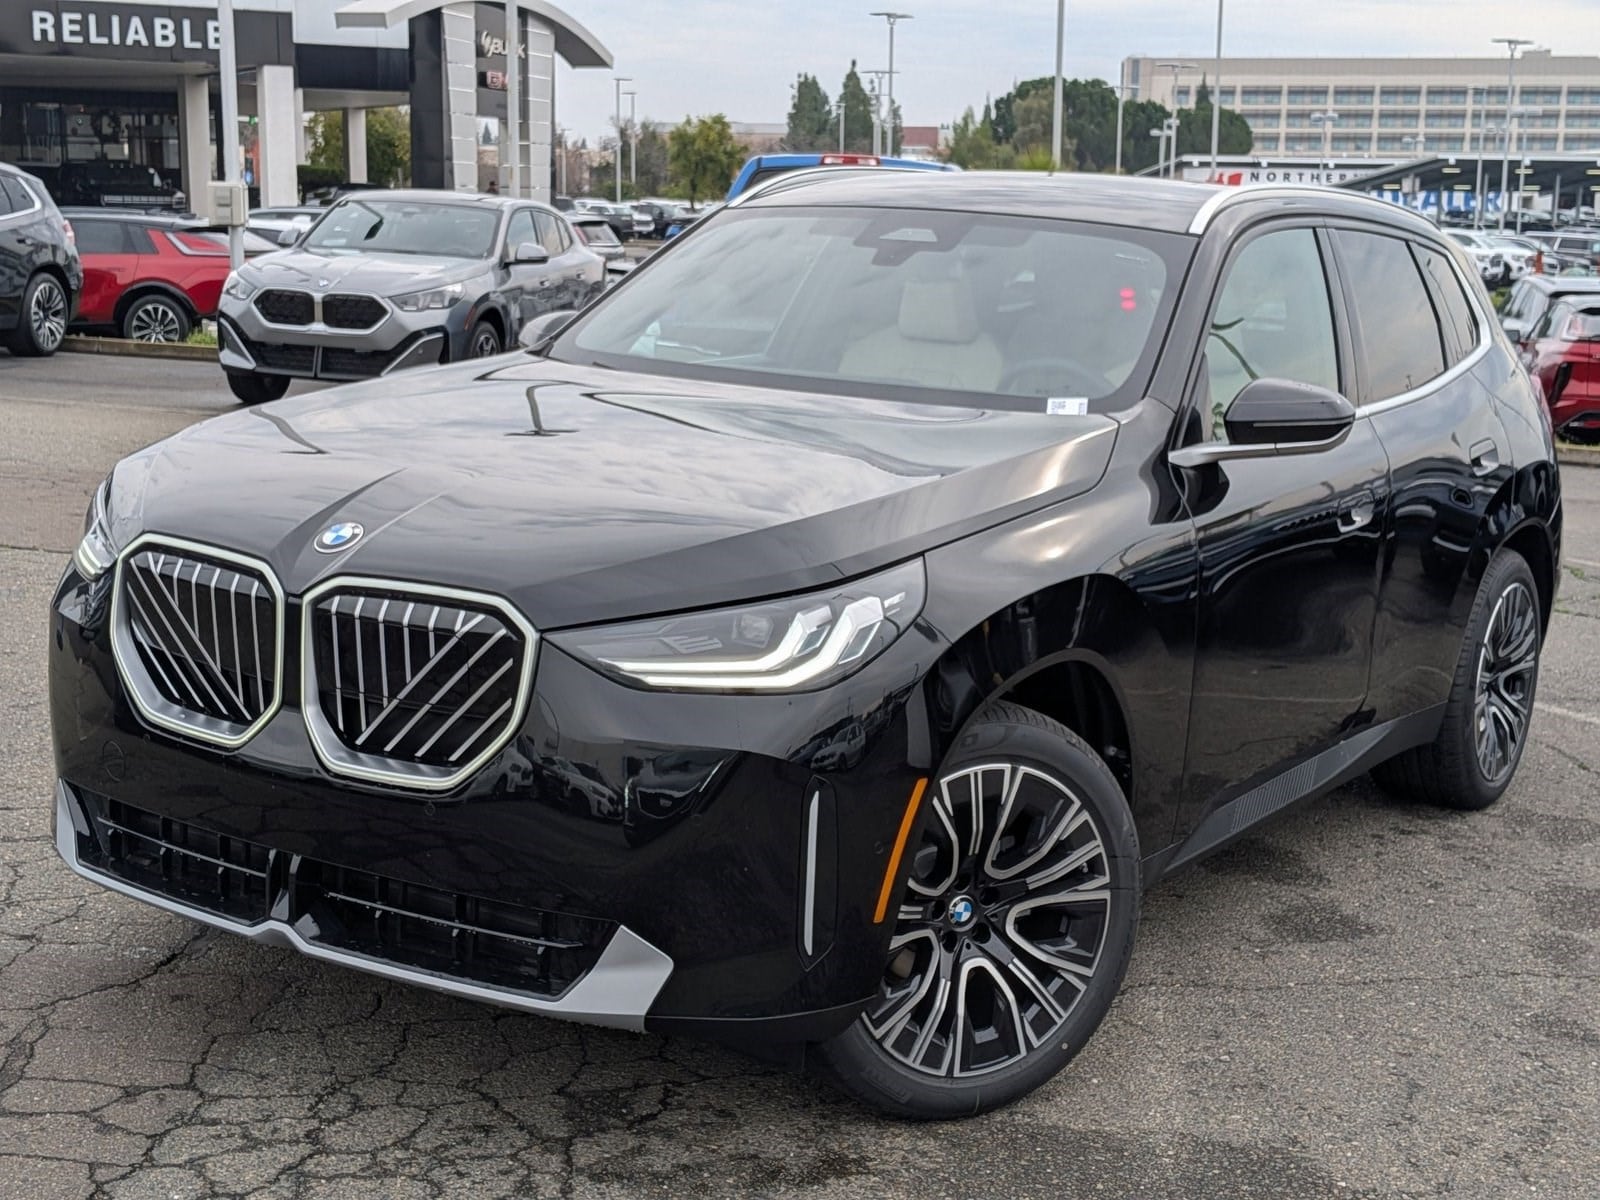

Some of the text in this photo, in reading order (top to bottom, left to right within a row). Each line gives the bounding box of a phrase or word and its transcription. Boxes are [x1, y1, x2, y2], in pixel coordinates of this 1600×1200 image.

[31, 10, 221, 50] RELIABLE
[492, 38, 526, 58] BUK
[1249, 171, 1362, 184] NORTHER
